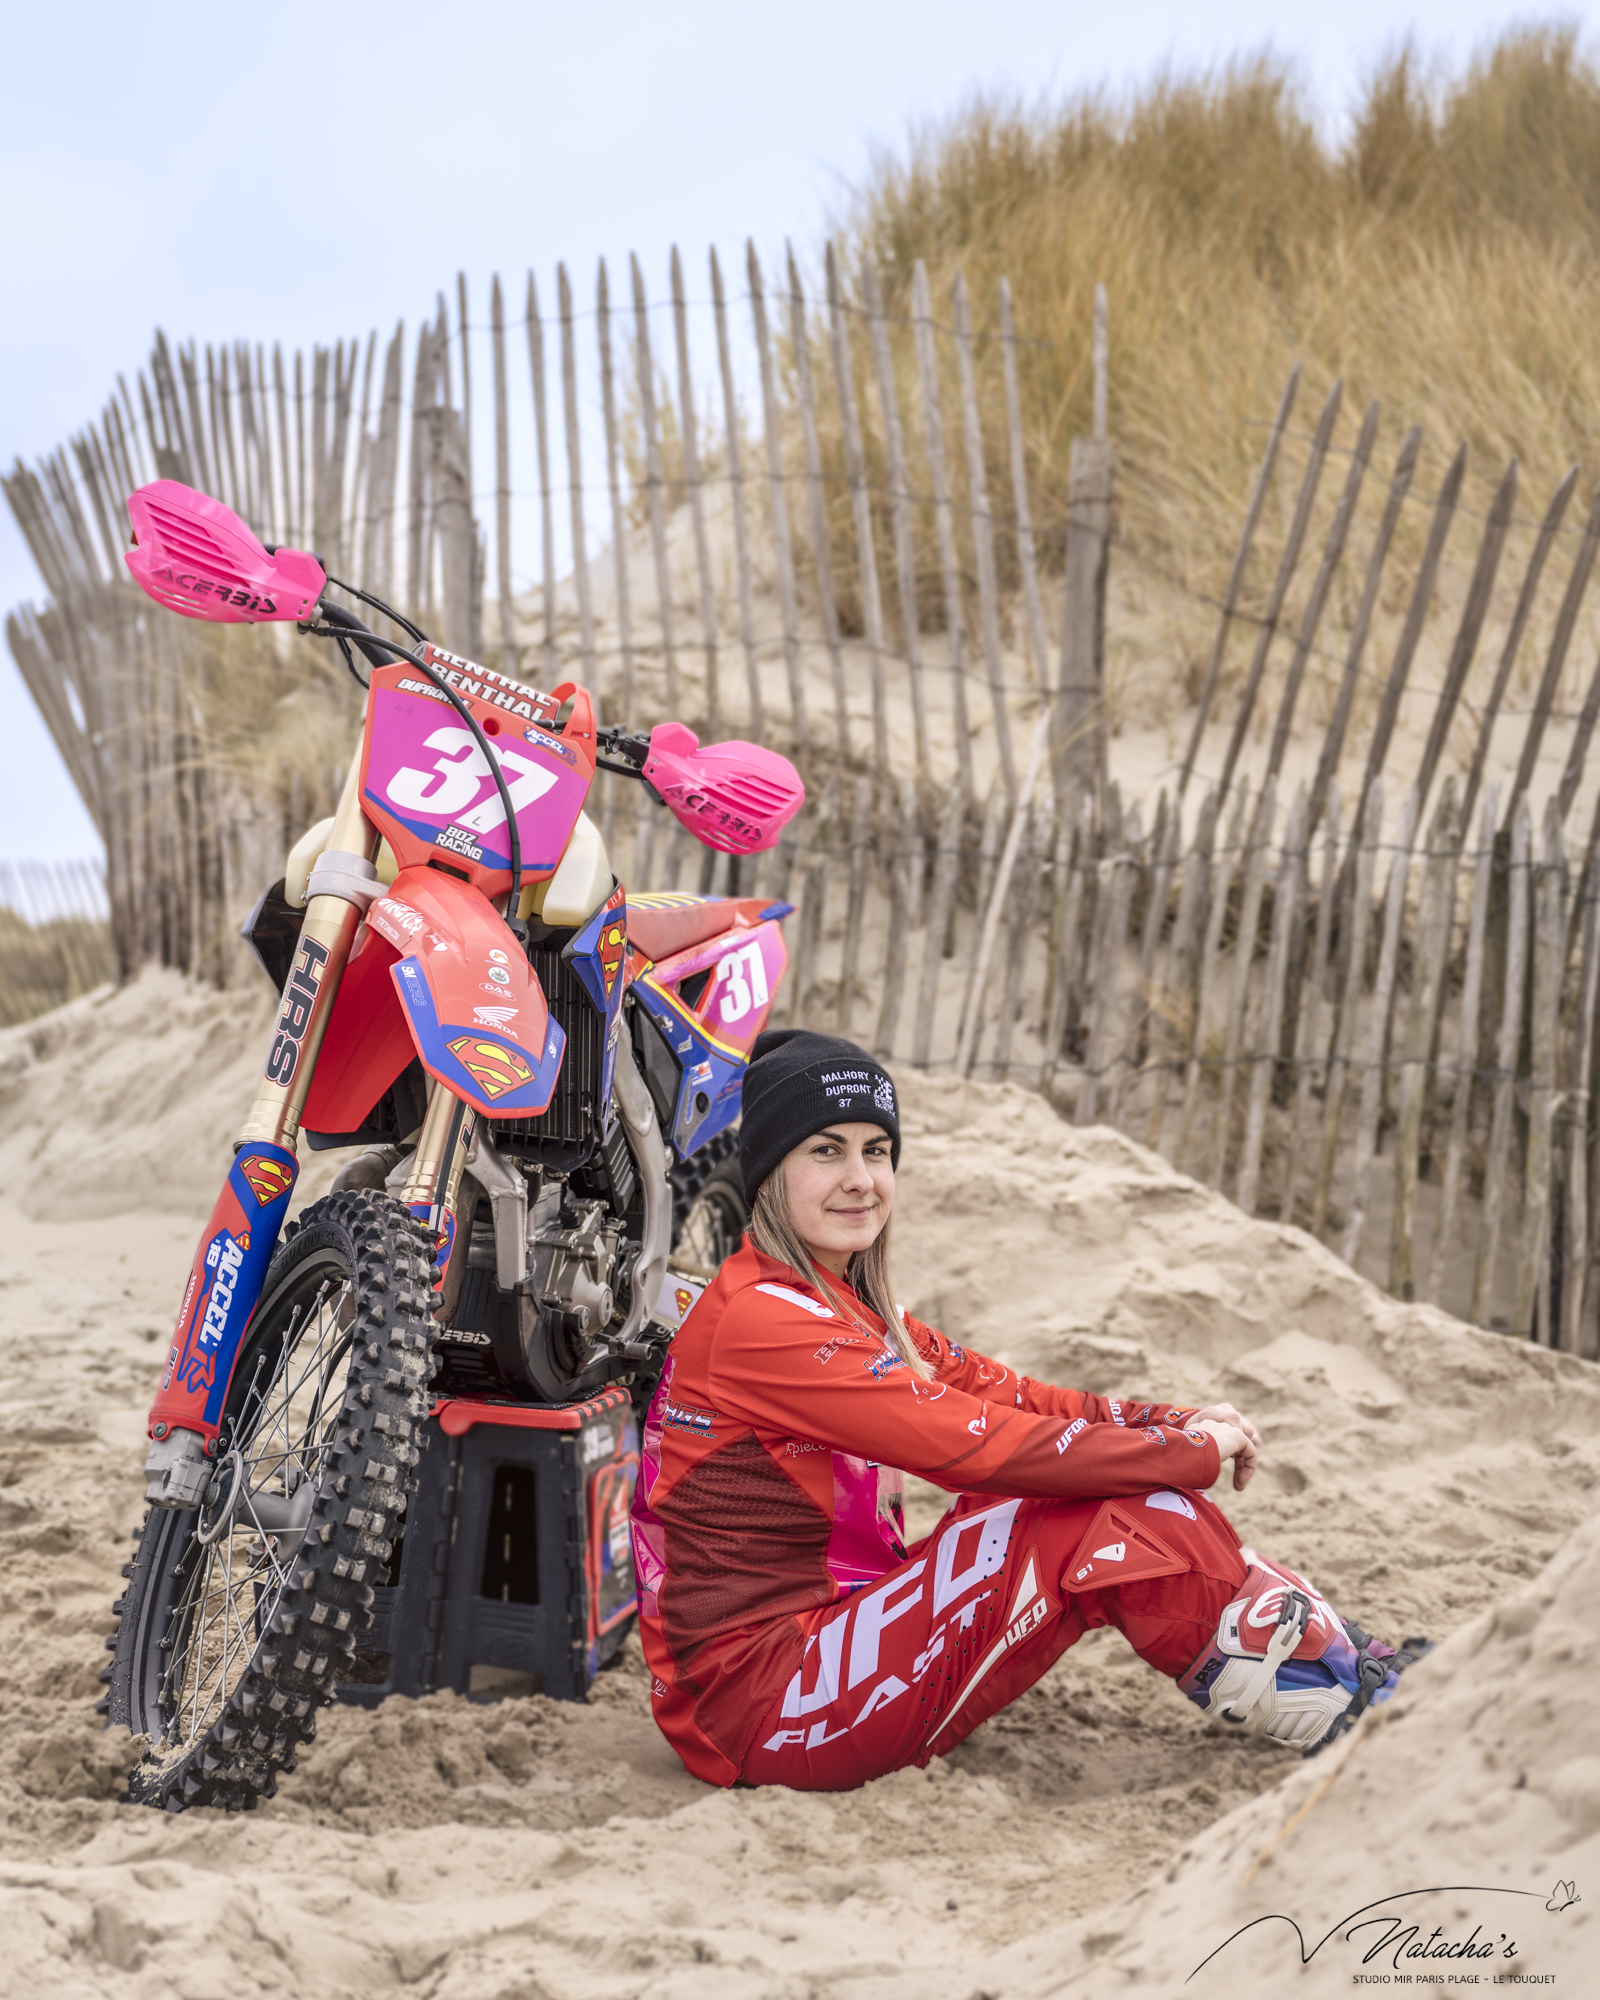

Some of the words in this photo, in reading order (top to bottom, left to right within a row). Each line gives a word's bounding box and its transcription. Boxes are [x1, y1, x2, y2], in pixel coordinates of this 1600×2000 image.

[151, 566, 277, 613] ACERBIS
[386, 726, 559, 835] 37
[665, 784, 762, 841] ACERBIS
[434, 832, 483, 861] RACING
[265, 935, 331, 1087] HRS
[472, 1017, 519, 1039] HONDA
[821, 1070, 869, 1083] MALHORY
[825, 1084, 871, 1096] DUPRONT
[838, 1098, 852, 1107] 37
[178, 1274, 197, 1331] HONDA
[440, 1329, 492, 1345] ERBIS
[1076, 1563, 1094, 1581] S1
[780, 1498, 1023, 1719] UFO
[1005, 1596, 1048, 1647] UFO
[762, 1590, 992, 1752] PLAST
